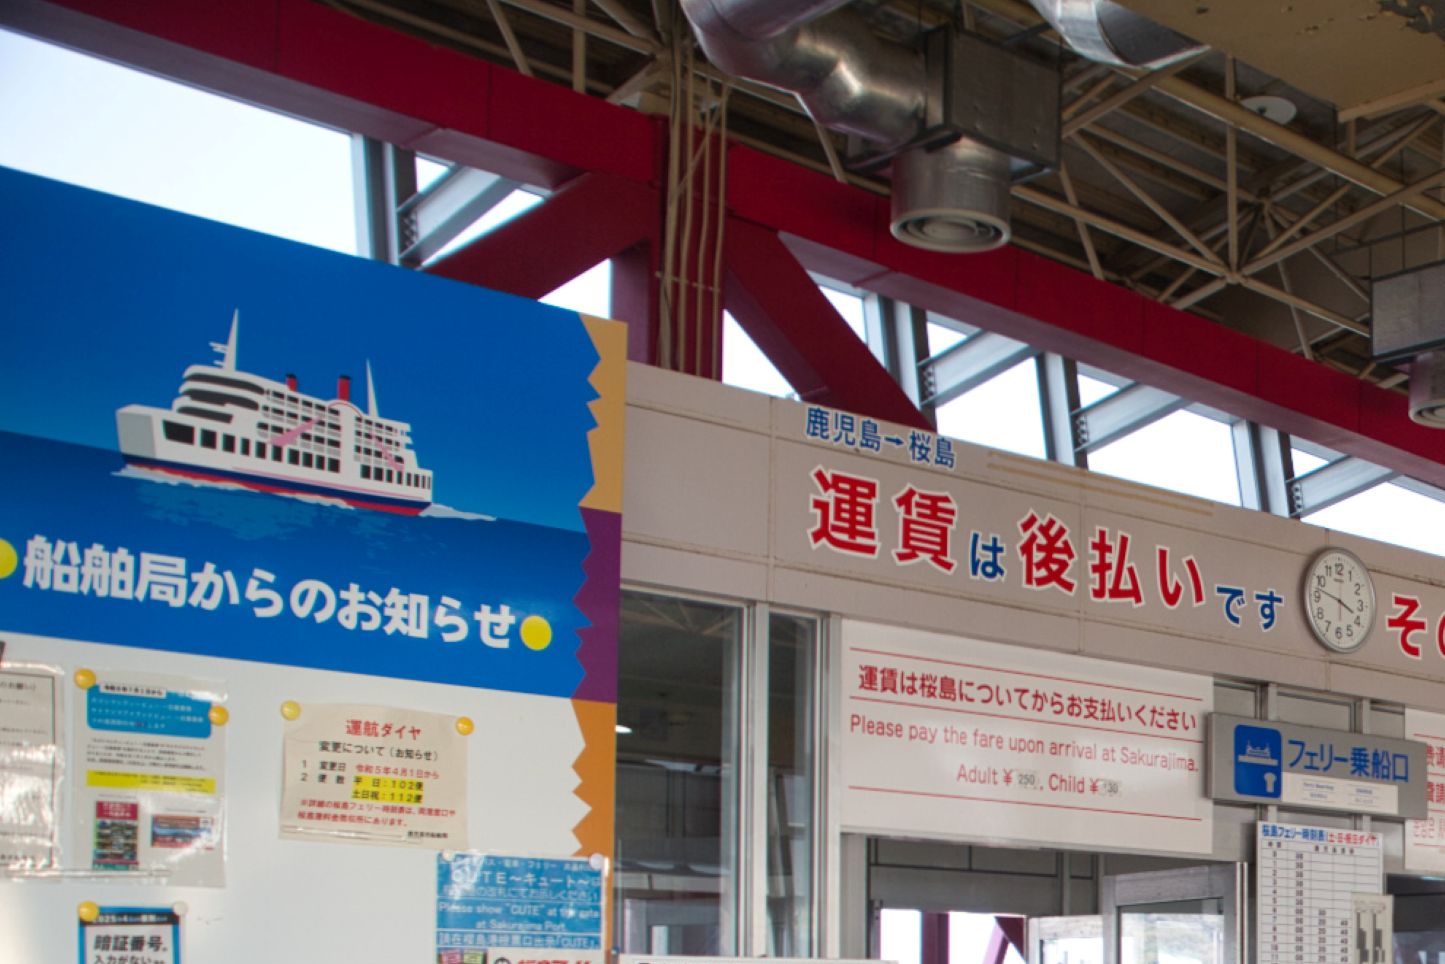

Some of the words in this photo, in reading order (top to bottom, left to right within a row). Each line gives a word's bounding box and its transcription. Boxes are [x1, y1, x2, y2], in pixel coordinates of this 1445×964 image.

[805, 406, 883, 453] 鹿児島
[908, 429, 956, 470] 桜島
[806, 463, 1285, 633] 運賃は後払いです
[1324, 565, 1333, 577] 11
[1334, 563, 1345, 576] 12
[1347, 570, 1352, 582] 1
[1316, 575, 1327, 588] 10
[22, 533, 517, 650] 船舶局からのお知らせ
[1353, 583, 1361, 596] 2
[1313, 590, 1321, 603] 9
[1356, 600, 1364, 612] 3
[1316, 607, 1324, 620] 8
[1324, 620, 1332, 633] 7
[1353, 615, 1361, 627] 4
[1335, 627, 1343, 640] 6
[1345, 625, 1354, 637] 5
[857, 663, 1198, 732] 運賃は桜島についてからお支払いください
[345, 719, 422, 741] 運航ダイヤ
[849, 713, 904, 740] Please
[907, 724, 939, 744] pay
[943, 724, 968, 746] the
[972, 727, 1004, 750] fare
[1008, 736, 1045, 757] upon
[1048, 738, 1098, 761] arrival
[1101, 745, 1118, 763] at
[1119, 745, 1200, 773] Sakurajima.
[1287, 739, 1410, 783] フェリー乗船口
[956, 764, 999, 786] Adult
[1047, 773, 1086, 795] Child
[476, 903, 503, 915] show
